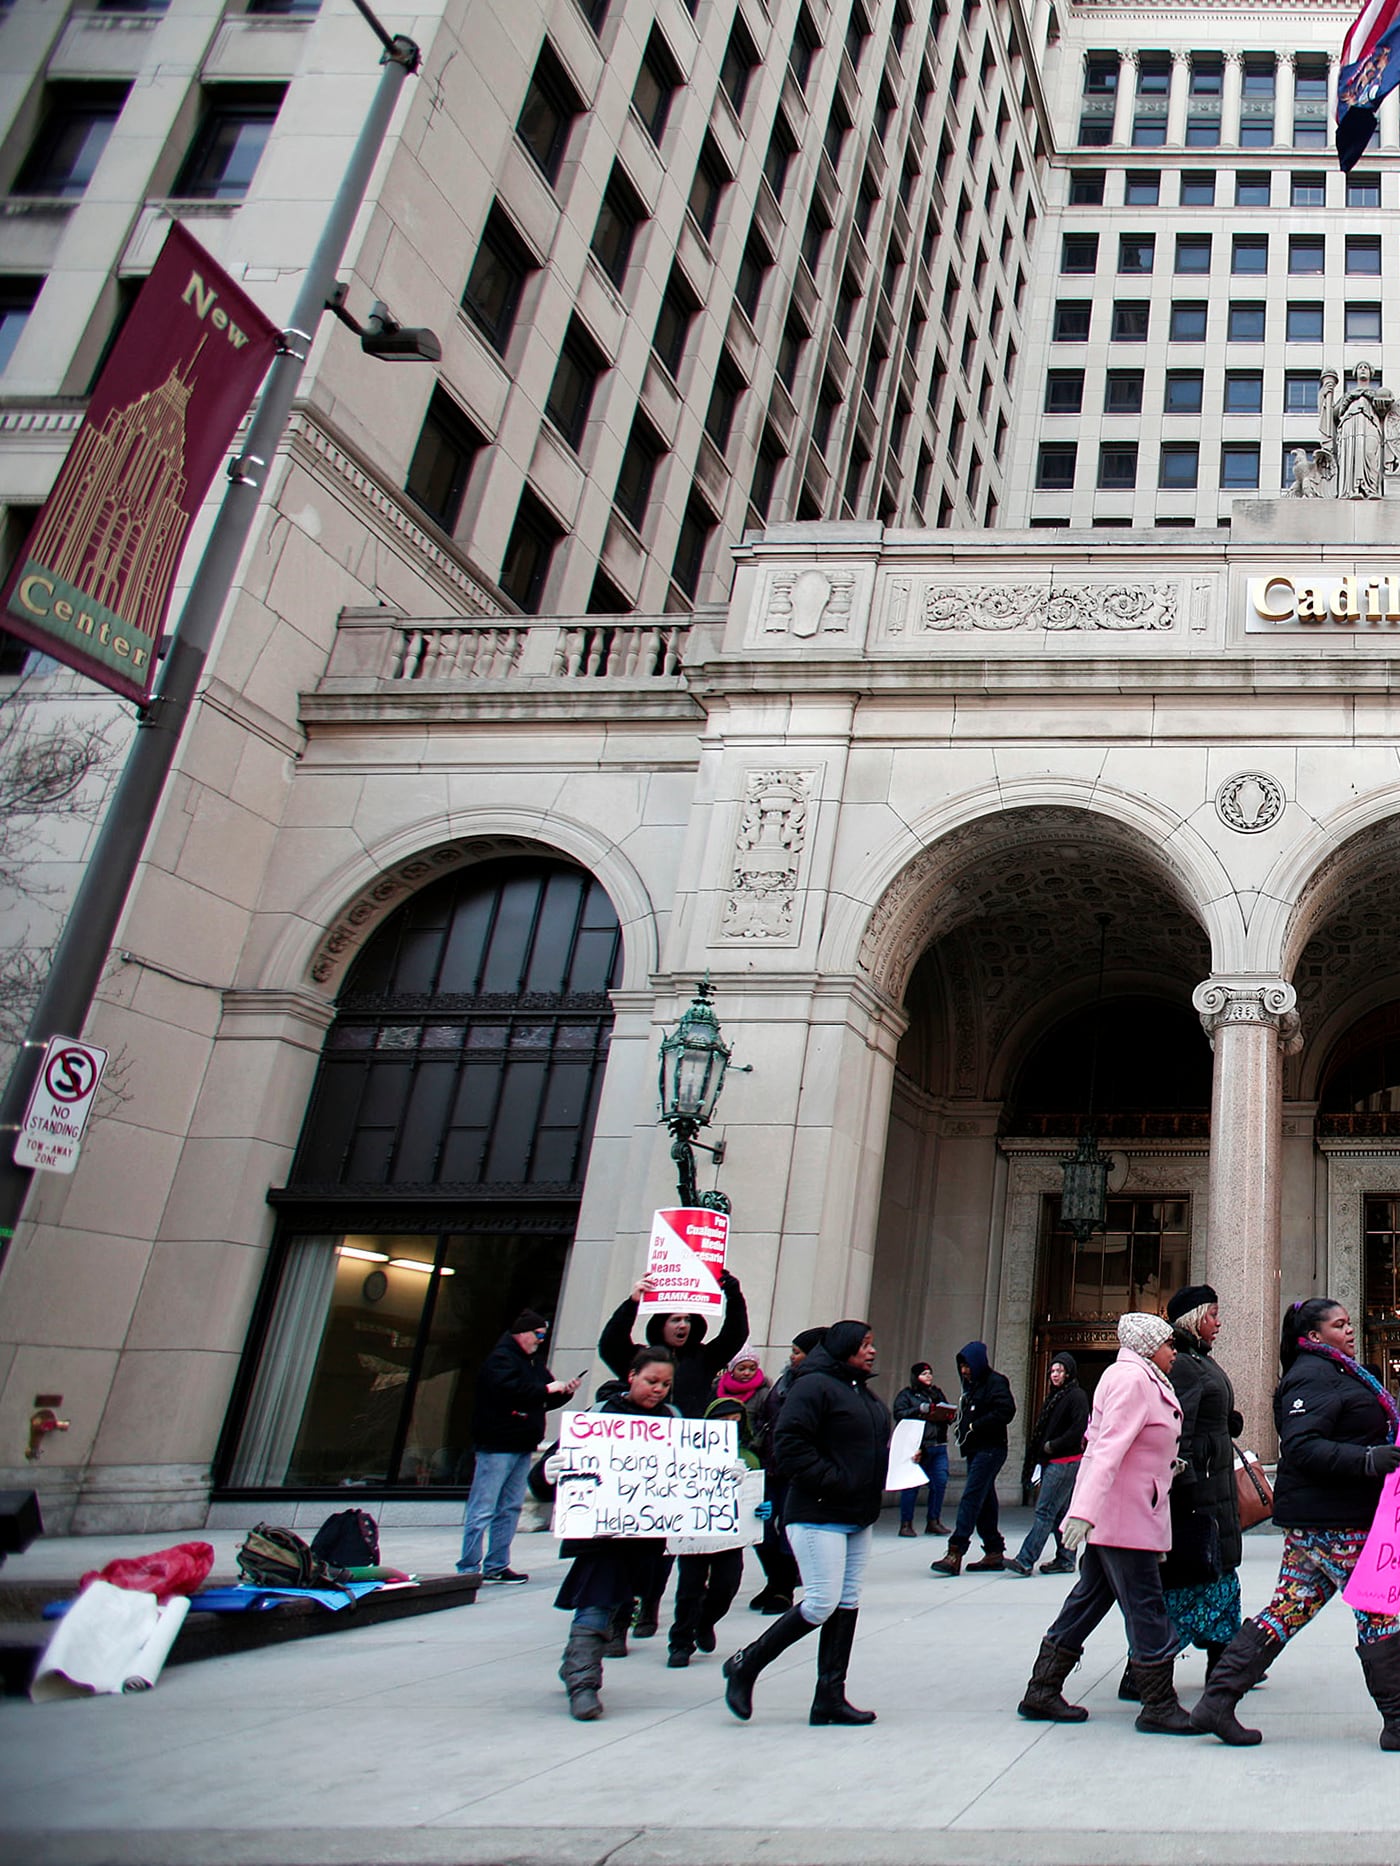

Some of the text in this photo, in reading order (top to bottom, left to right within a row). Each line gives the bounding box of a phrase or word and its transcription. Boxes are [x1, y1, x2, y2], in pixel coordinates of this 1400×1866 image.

[181, 269, 249, 349] New
[18, 575, 148, 667] Center
[51, 1104, 70, 1120] NO
[30, 1116, 80, 1139] STANDING
[34, 1153, 57, 1167] ZONE
[654, 1236, 665, 1247] By
[652, 1249, 668, 1261] Any
[651, 1263, 681, 1273] Means
[653, 1277, 700, 1288] ecessary
[657, 1292, 710, 1302] BAMN.com
[570, 1414, 730, 1454] Save me! Help!
[609, 1445, 658, 1479] being
[665, 1447, 737, 1488] destroye
[618, 1477, 741, 1504] by Rick Snyder
[639, 1505, 684, 1533] Save
[690, 1499, 739, 1534] DPS!
